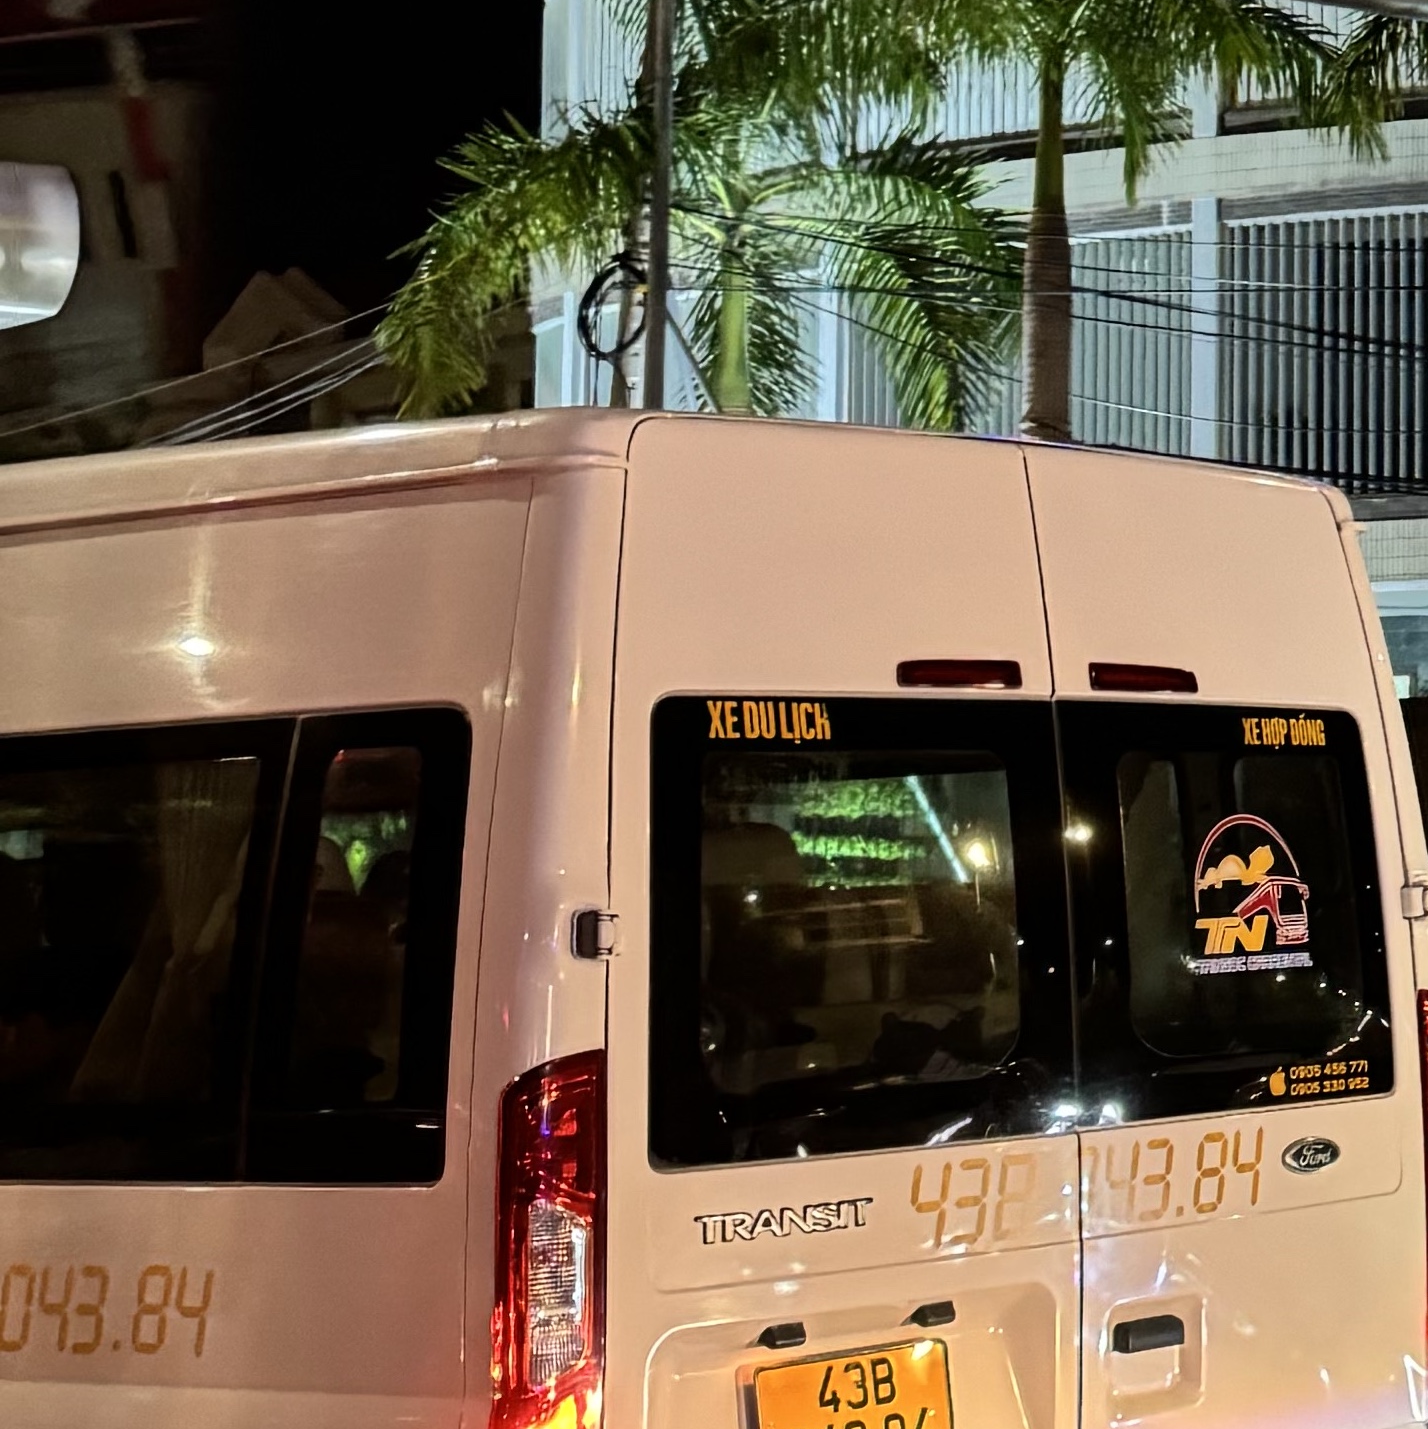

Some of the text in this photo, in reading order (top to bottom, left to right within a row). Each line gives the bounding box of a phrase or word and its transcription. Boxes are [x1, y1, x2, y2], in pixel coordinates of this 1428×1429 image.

[706, 700, 831, 744] XE DU LỊCH
[1242, 717, 1262, 745] XE
[1349, 1059, 1368, 1073] 771
[694, 1197, 874, 1245] TRANSIT
[0, 1264, 215, 1358] 043.84
[818, 1357, 897, 1412] 43B
